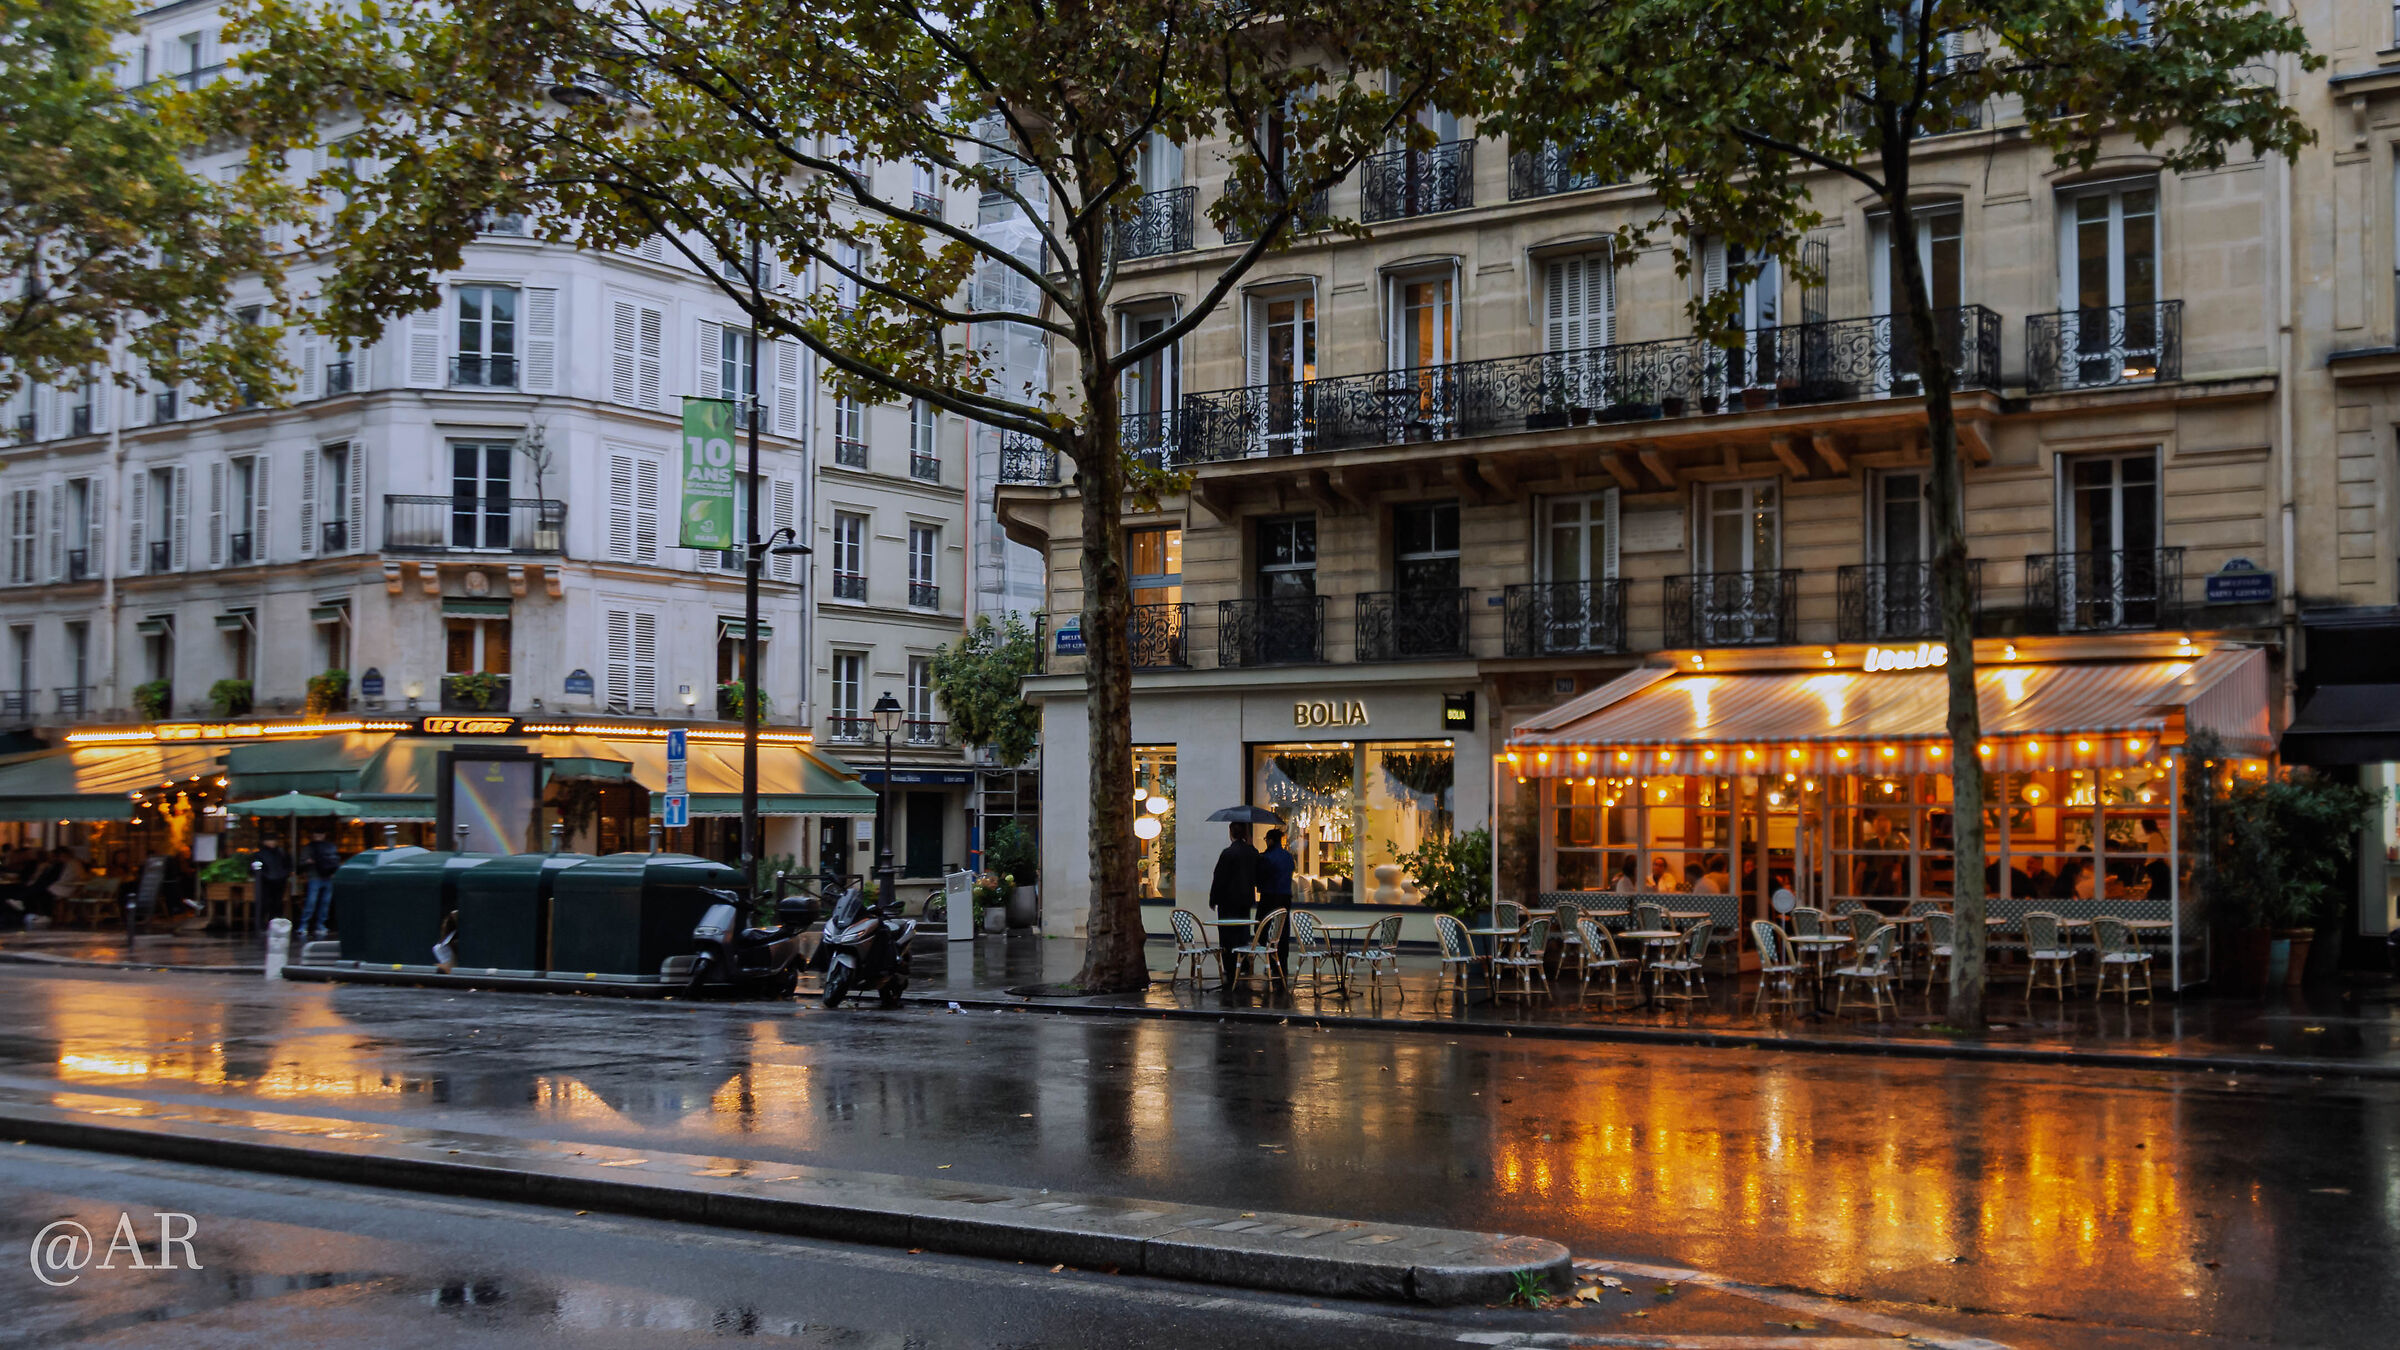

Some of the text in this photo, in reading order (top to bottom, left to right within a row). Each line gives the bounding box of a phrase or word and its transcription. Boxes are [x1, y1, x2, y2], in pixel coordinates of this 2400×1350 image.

[687, 436, 731, 467] 10
[687, 466, 731, 482] ANS
[1557, 679, 1573, 692] 90
[1294, 702, 1368, 727] BOLIA
[1447, 709, 1466, 721] BOLIA
